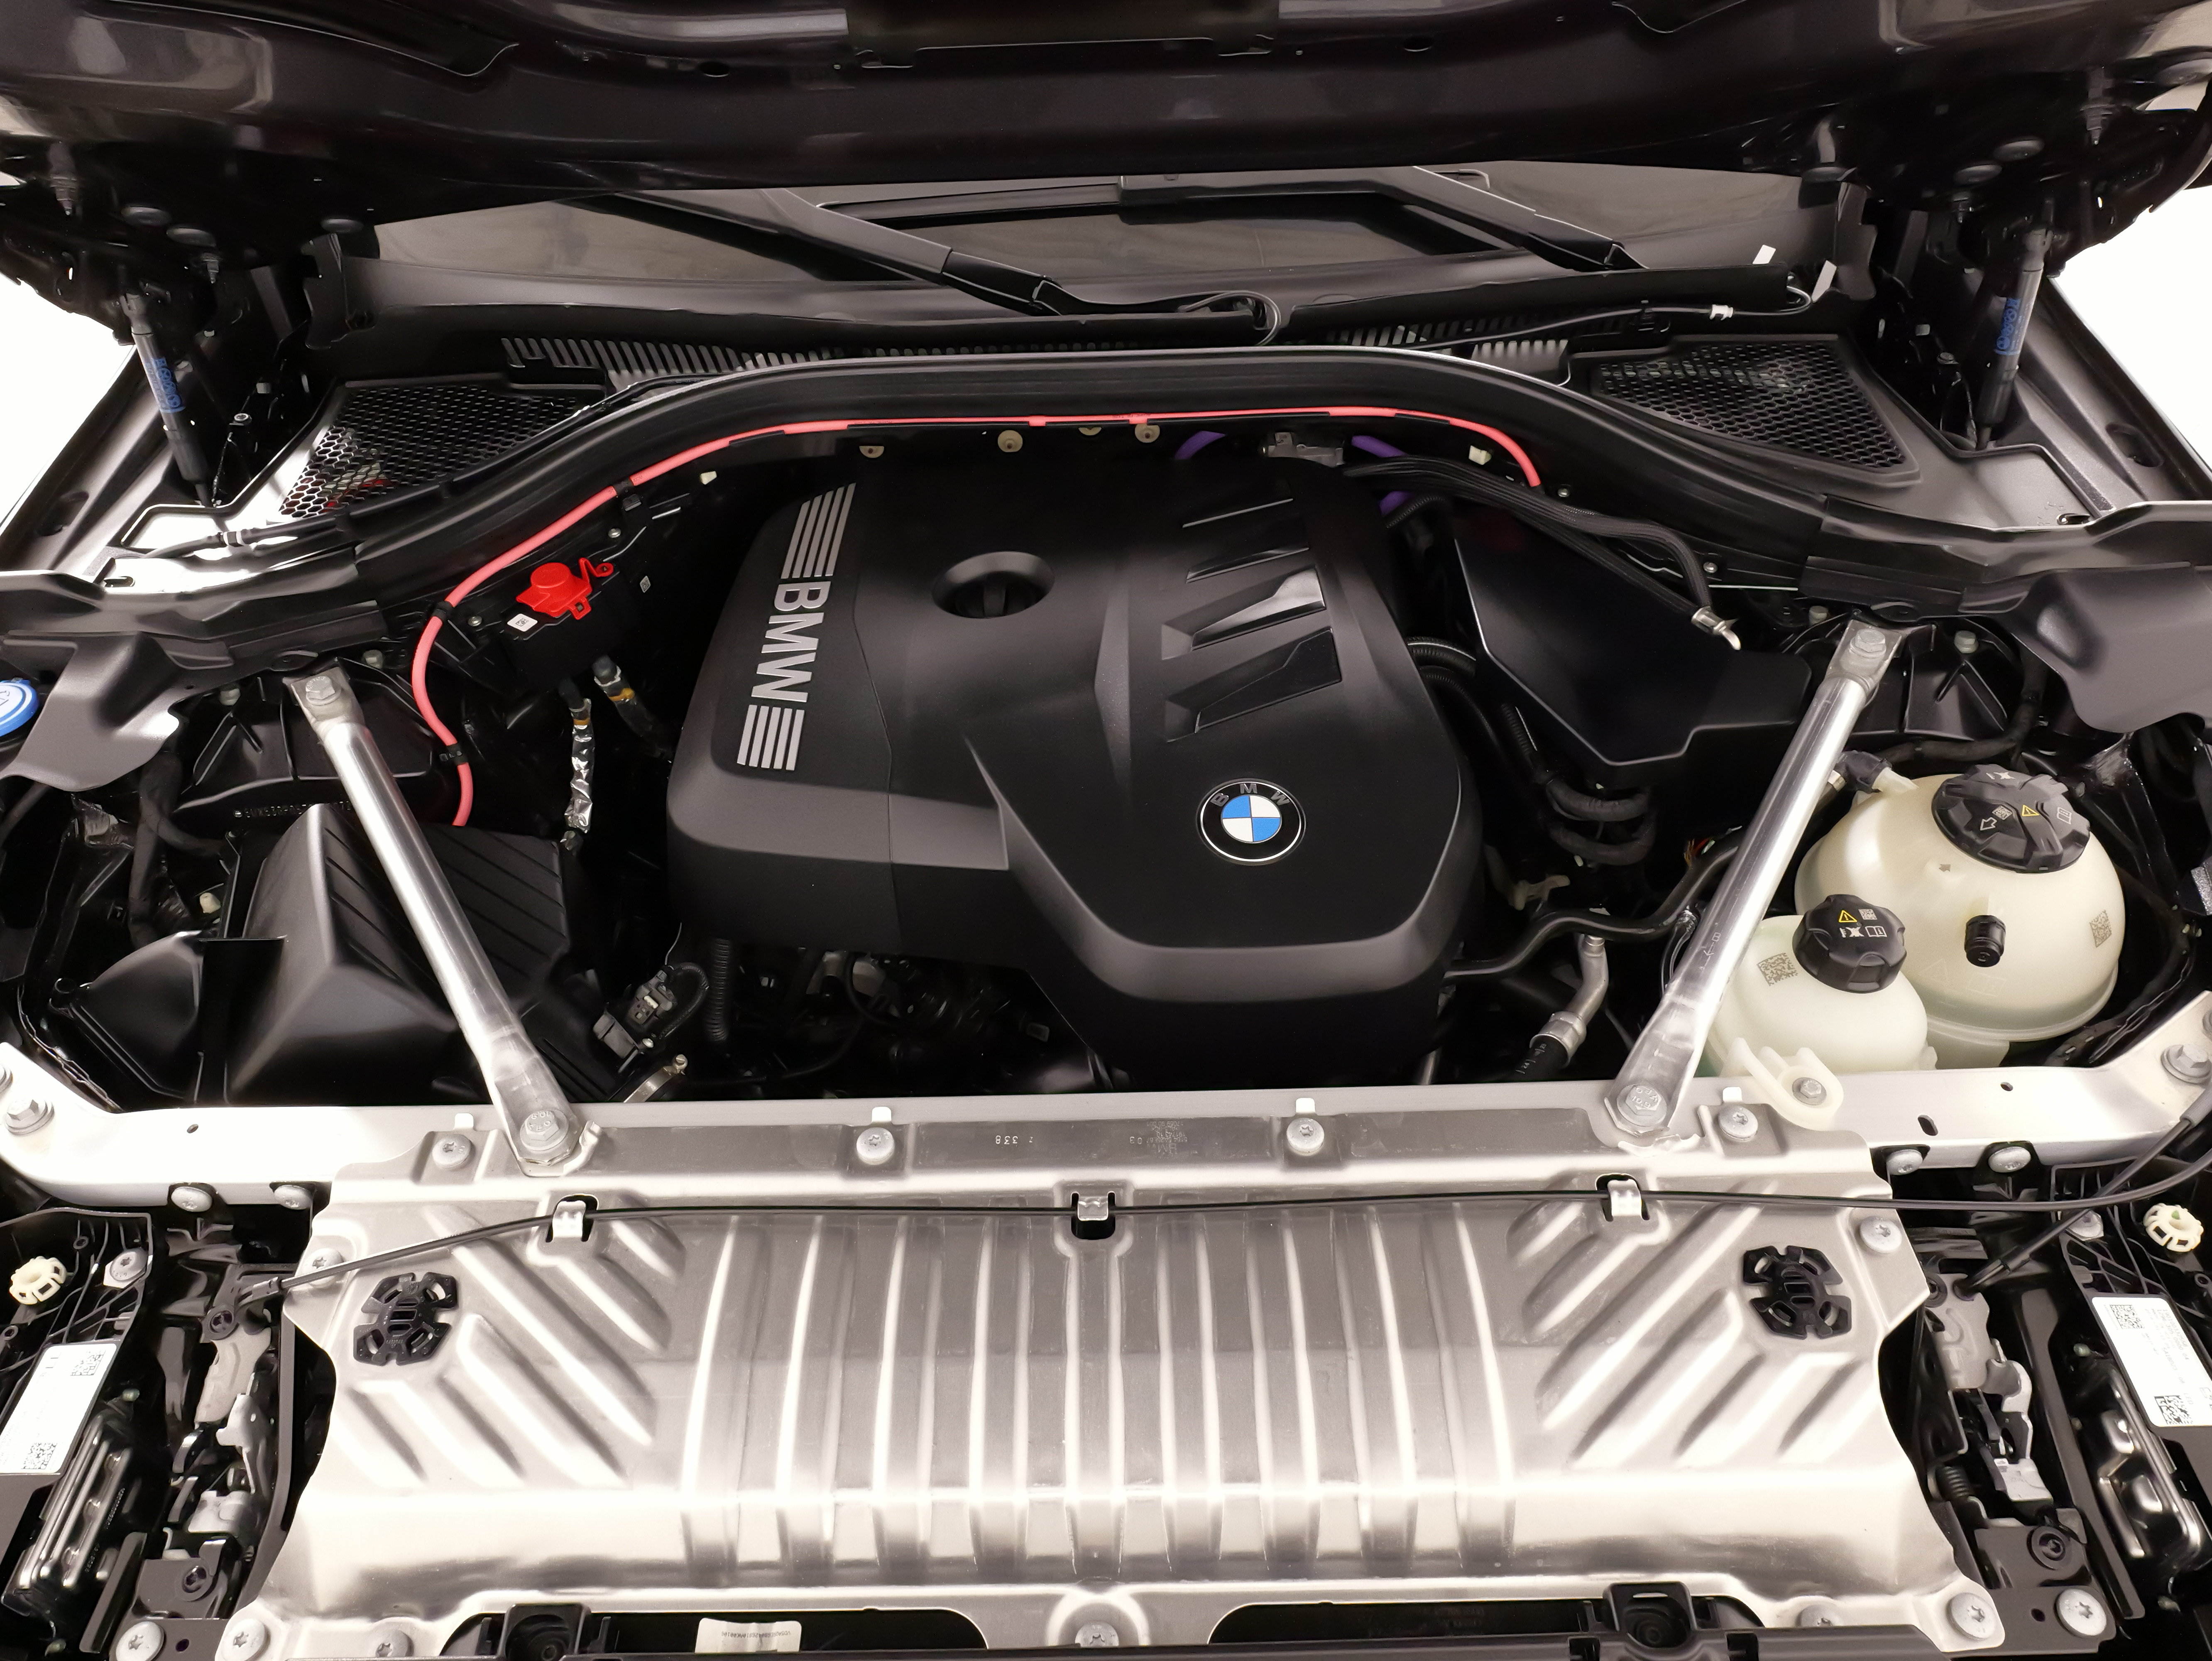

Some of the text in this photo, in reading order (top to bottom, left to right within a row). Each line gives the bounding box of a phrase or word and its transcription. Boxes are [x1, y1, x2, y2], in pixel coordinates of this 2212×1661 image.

[751, 581, 832, 703] BMW
[1210, 783, 1290, 807] BMW
[995, 1135, 1018, 1144] 338
